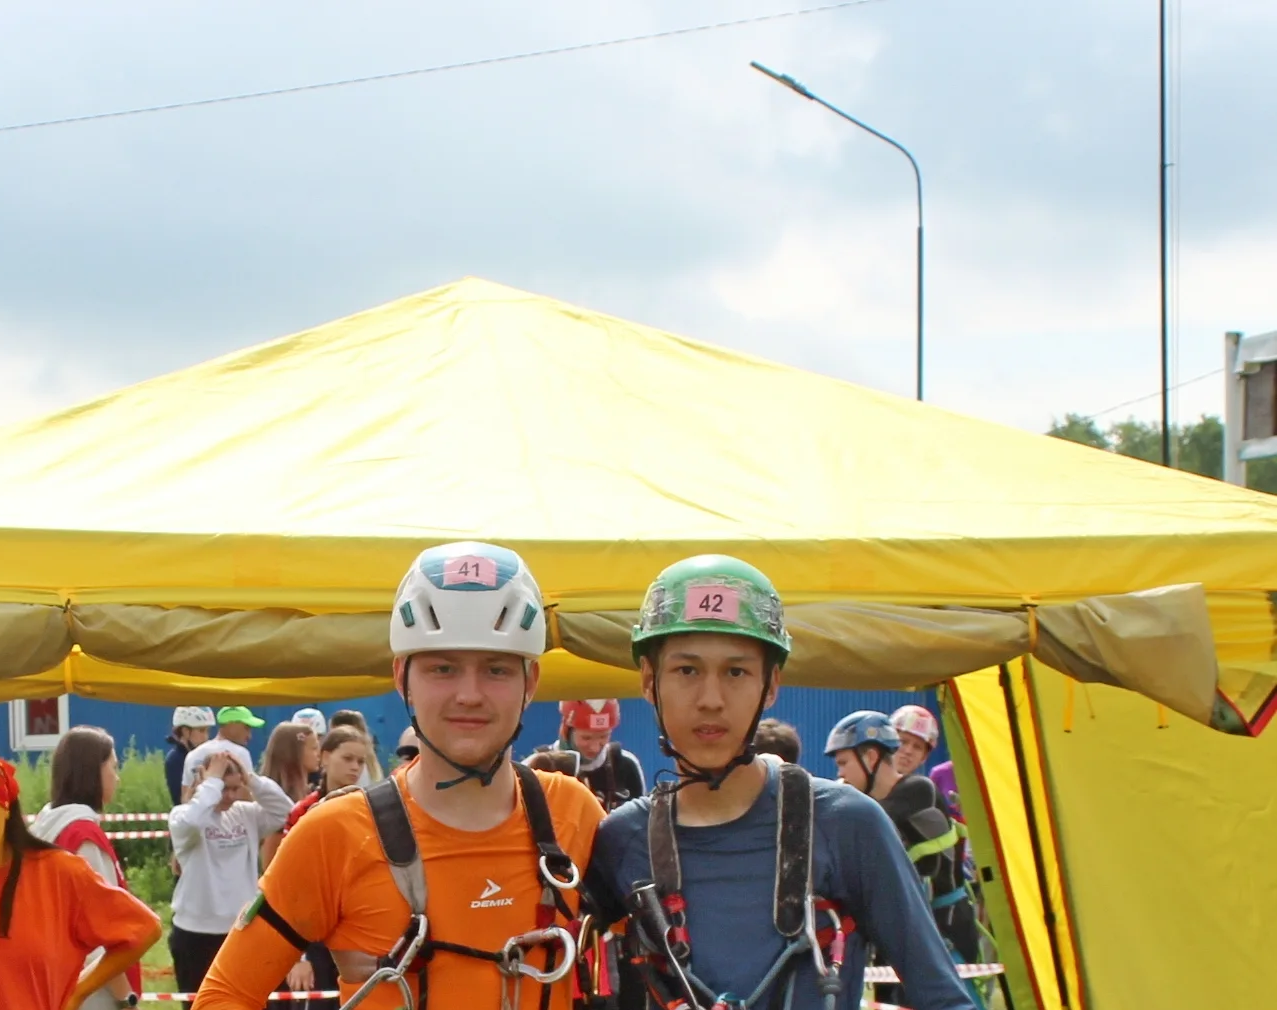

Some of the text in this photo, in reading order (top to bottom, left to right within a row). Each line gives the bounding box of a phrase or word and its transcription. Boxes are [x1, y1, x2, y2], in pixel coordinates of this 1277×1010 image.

[458, 562, 480, 577] 41
[699, 594, 723, 612] 42
[470, 898, 514, 908] DEMIX
